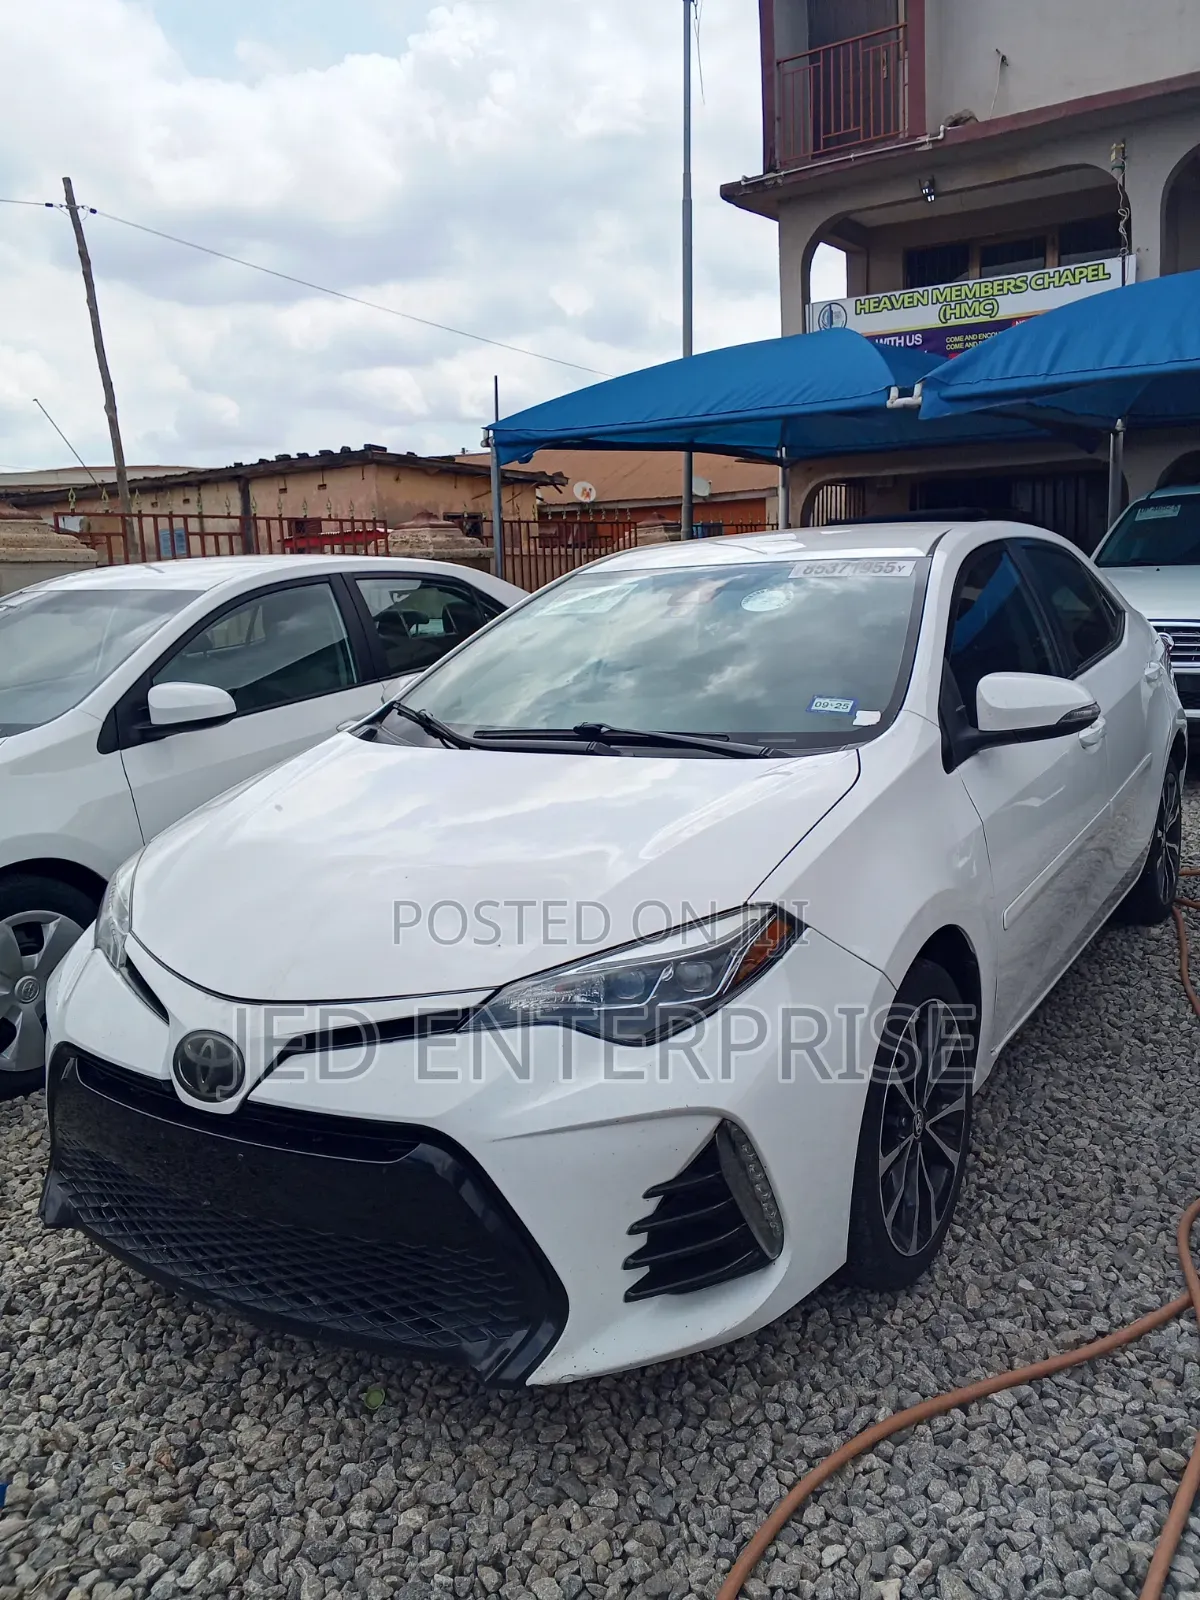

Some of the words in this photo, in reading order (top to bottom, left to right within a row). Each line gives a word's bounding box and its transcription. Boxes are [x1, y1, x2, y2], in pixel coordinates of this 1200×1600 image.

[855, 290, 928, 315] HEAVEN
[931, 276, 1028, 305] MEMBERS
[1029, 263, 1111, 289] CHAPEL
[938, 298, 1000, 324] (HMC)
[906, 333, 923, 347] US
[945, 335, 964, 343] COME
[964, 333, 978, 341] AND
[945, 342, 964, 351] COME
[964, 341, 978, 349] AND
